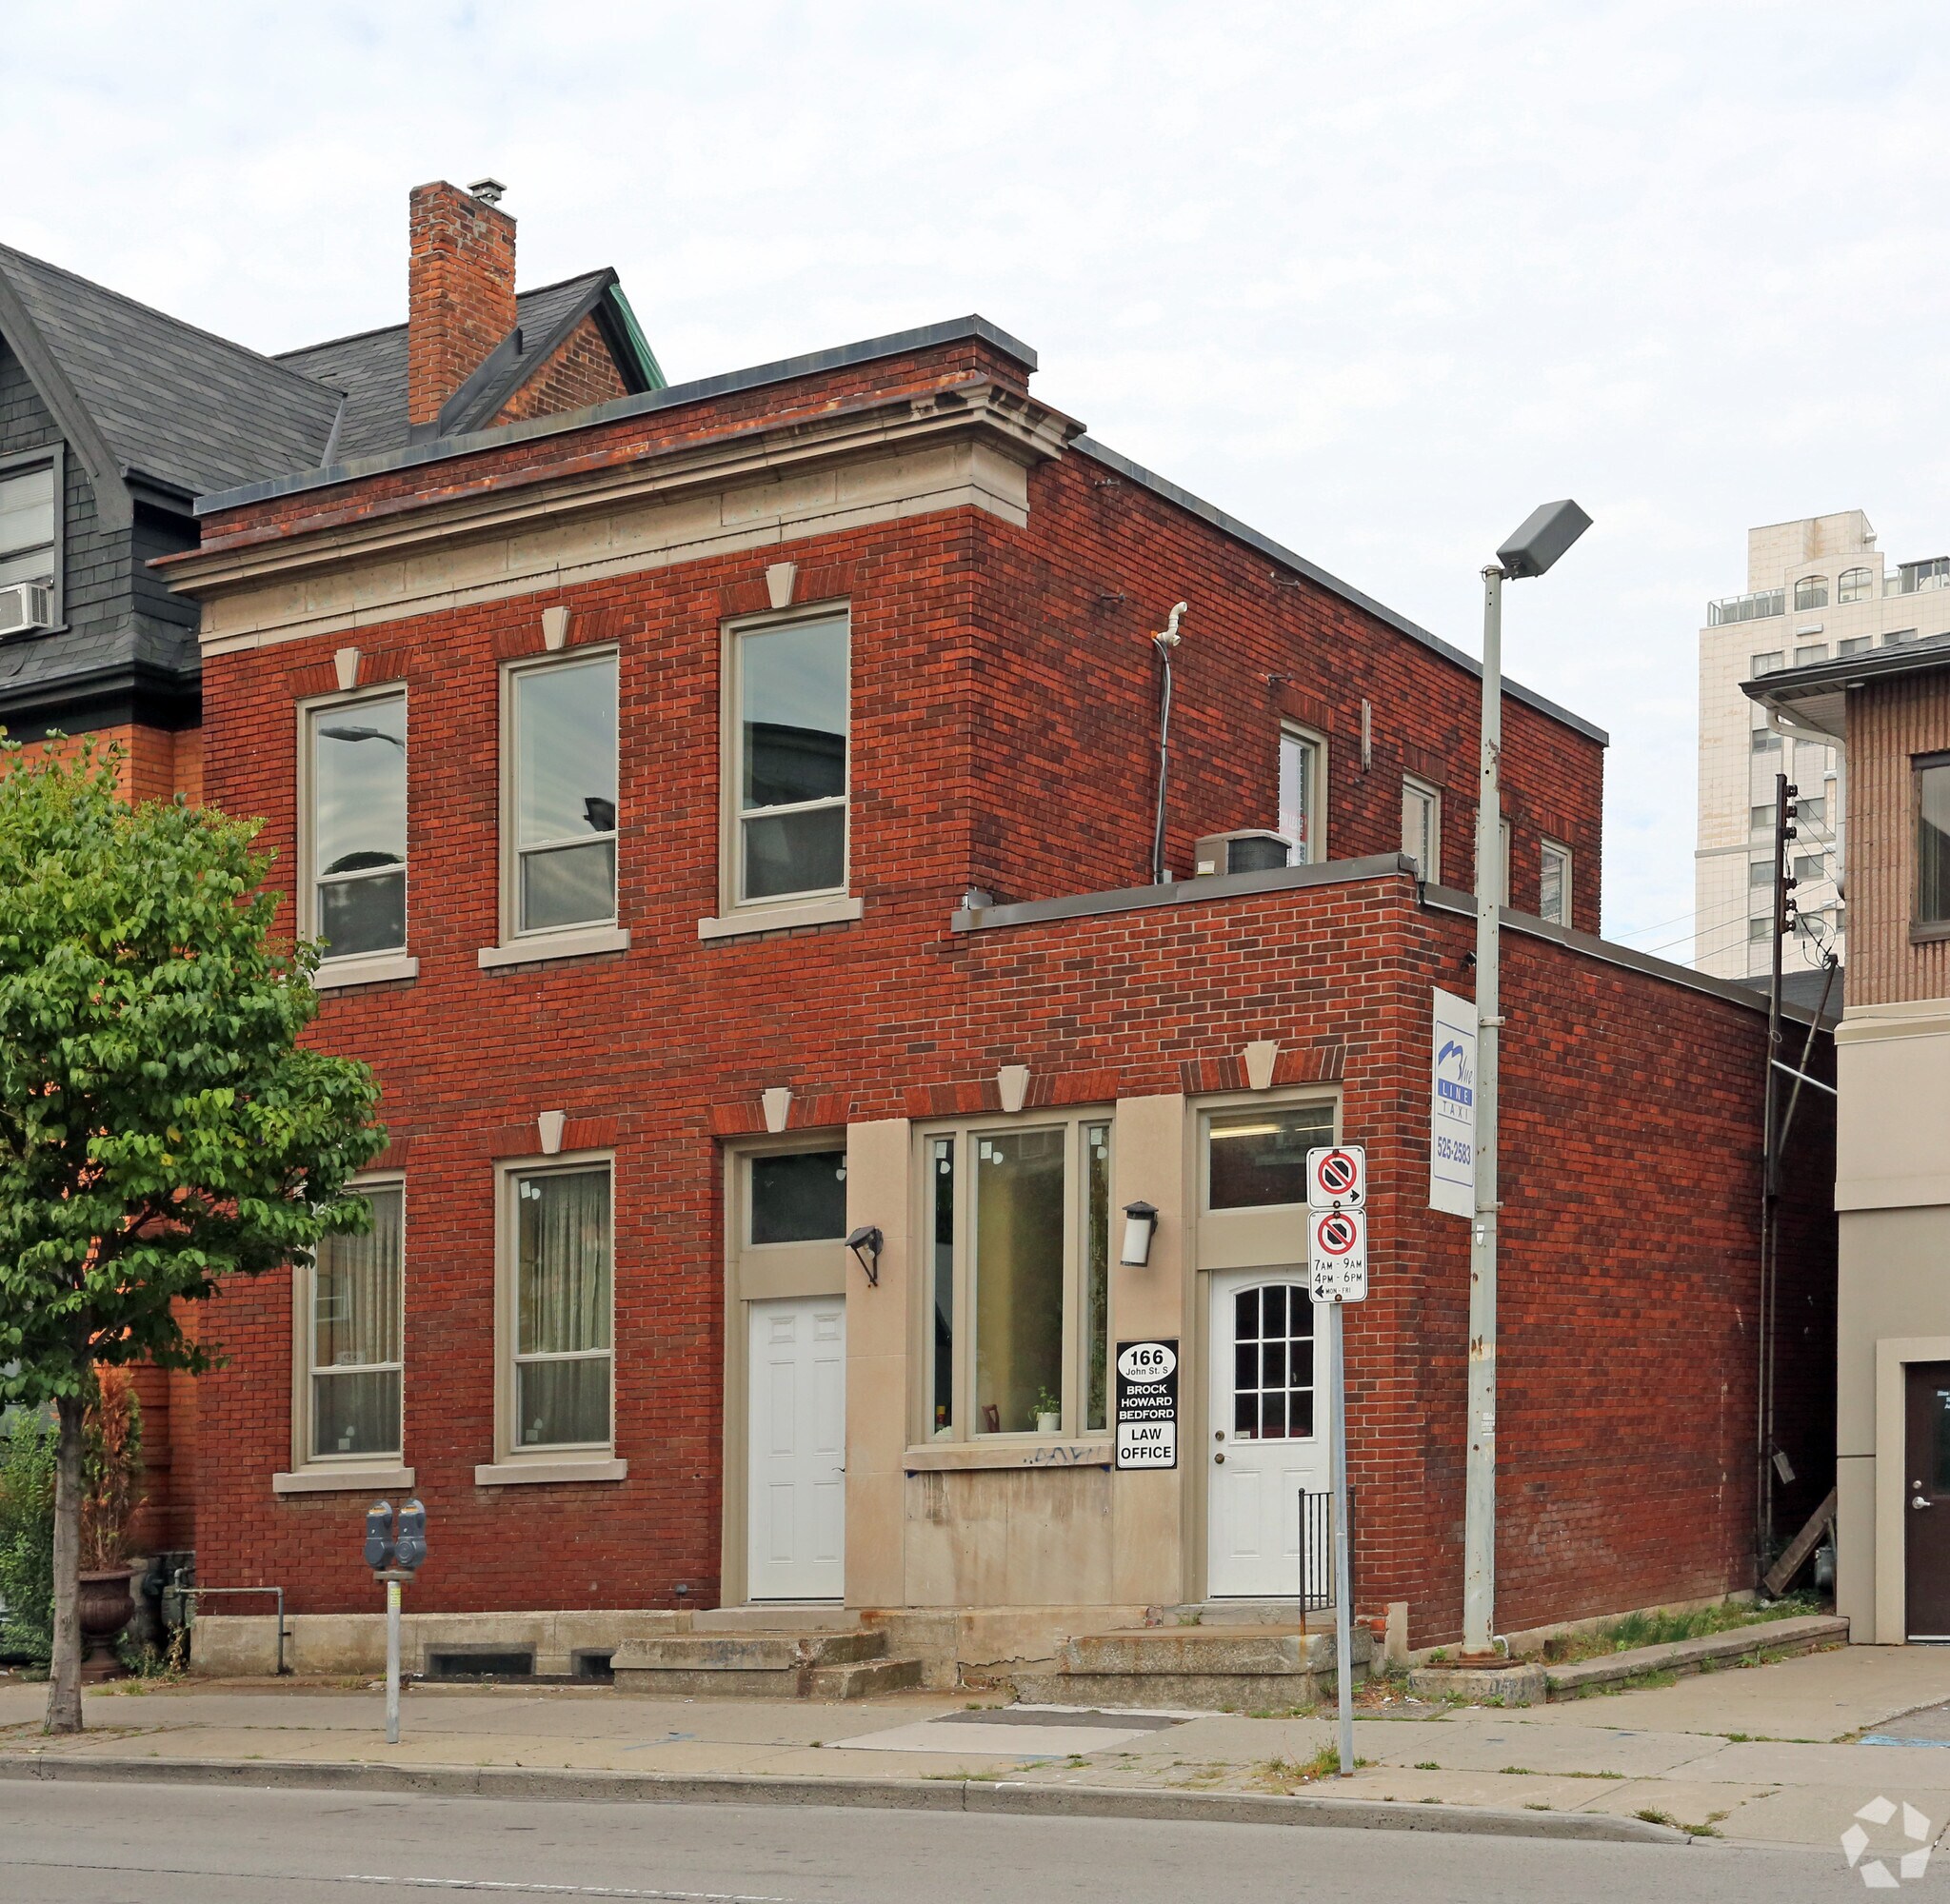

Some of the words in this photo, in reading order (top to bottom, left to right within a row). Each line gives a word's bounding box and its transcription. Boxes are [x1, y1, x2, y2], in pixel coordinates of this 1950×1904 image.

[1443, 1081, 1468, 1103] LINE
[1443, 1101, 1468, 1120] TAXI
[1314, 1259, 1332, 1271] 7AM
[1343, 1258, 1363, 1269] 9AM
[1314, 1273, 1334, 1284] 4PM
[1343, 1271, 1363, 1282] 6PM
[1130, 1349, 1164, 1366] 166
[1148, 1366, 1160, 1375] St.
[1126, 1384, 1167, 1396] BROCK
[1121, 1397, 1173, 1407] HOWARD
[1119, 1409, 1175, 1420] BEDFORD
[1131, 1428, 1162, 1440] LAW
[1121, 1446, 1171, 1459] OFFICE
